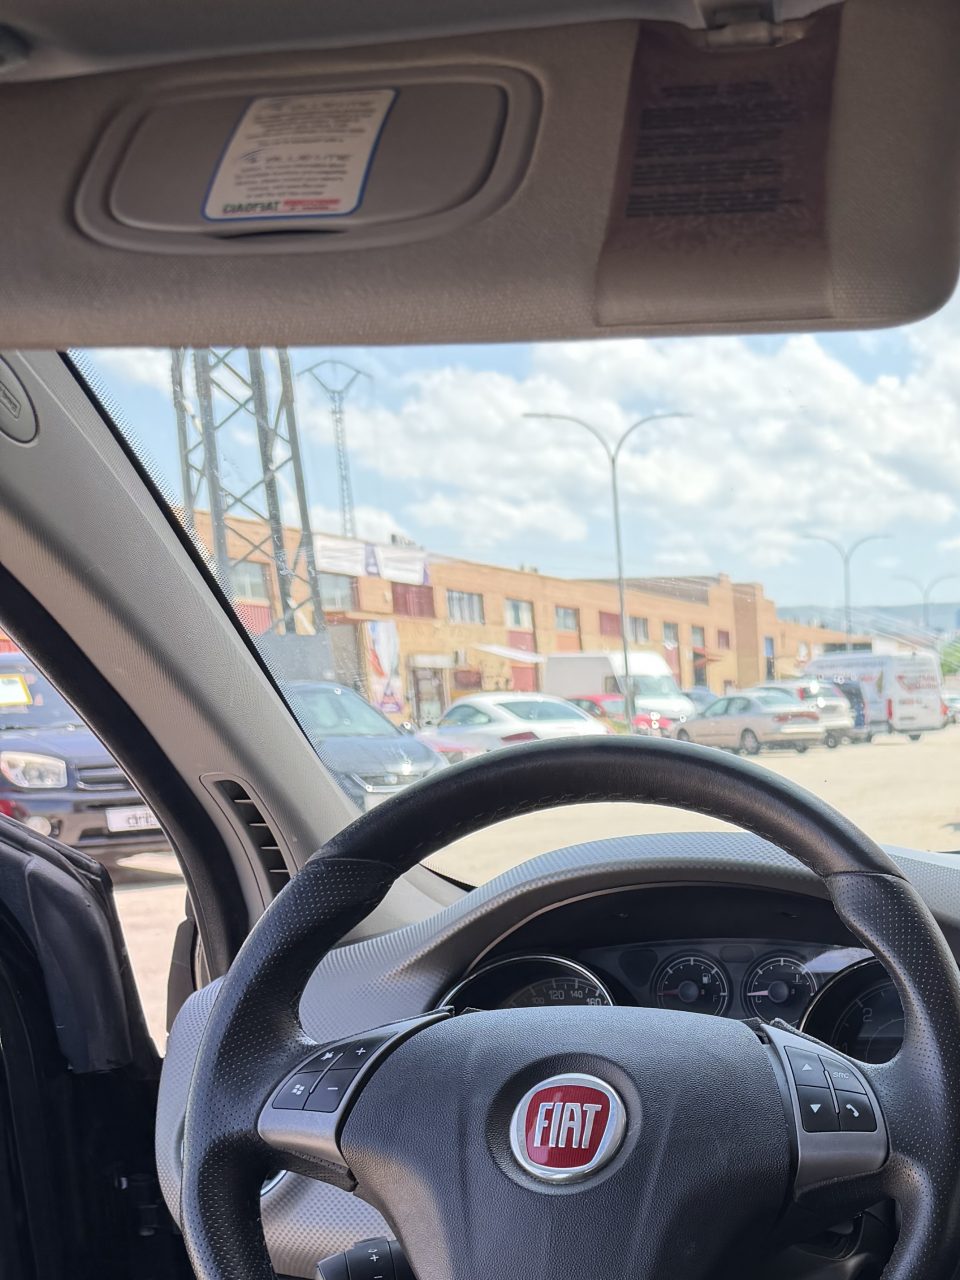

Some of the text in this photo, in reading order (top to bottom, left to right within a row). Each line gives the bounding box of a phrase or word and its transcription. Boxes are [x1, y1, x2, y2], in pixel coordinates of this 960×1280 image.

[548, 990, 565, 1000] 120
[570, 990, 583, 999] 140
[862, 1007, 873, 1022] 2
[533, 1102, 603, 1149] FIAT
